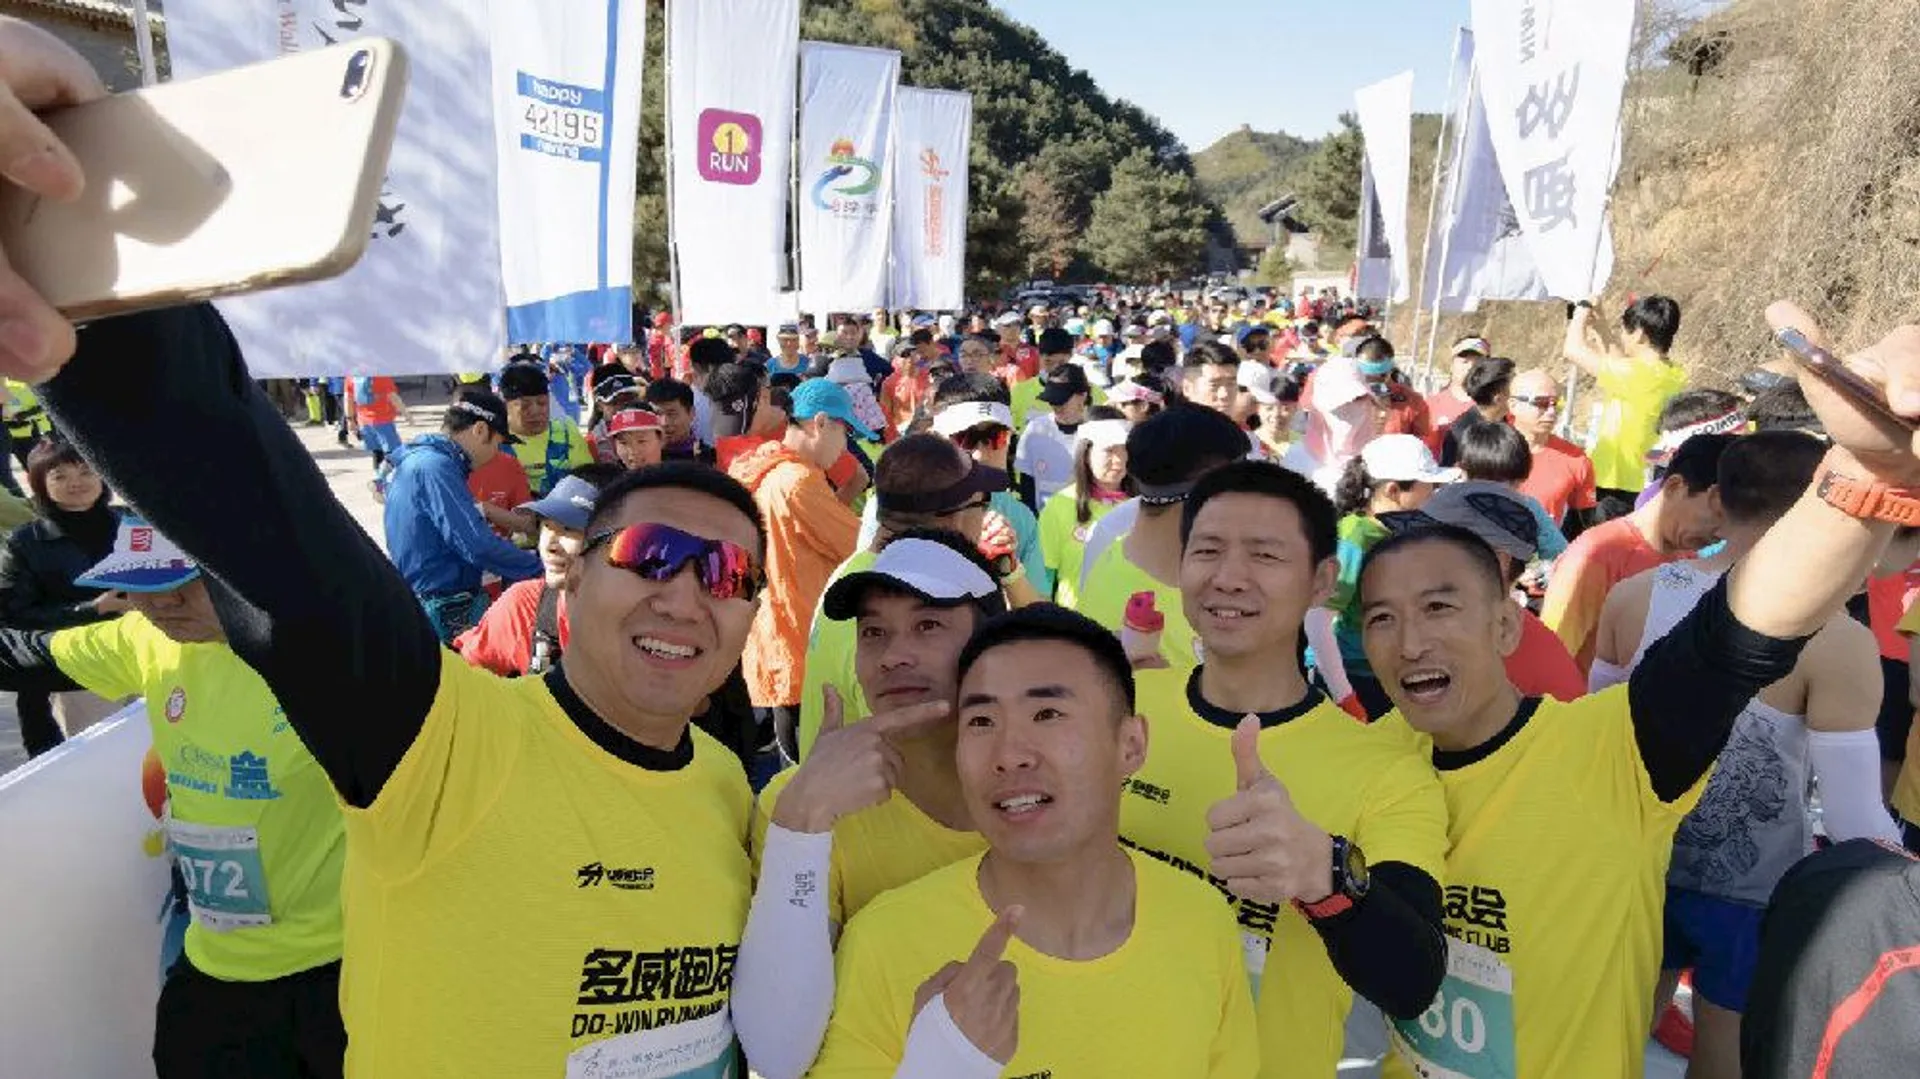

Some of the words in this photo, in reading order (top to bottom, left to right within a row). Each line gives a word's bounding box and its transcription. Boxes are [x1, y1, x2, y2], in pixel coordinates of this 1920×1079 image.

[532, 79, 582, 105] happy
[524, 103, 597, 144] 42195
[723, 129, 733, 153] 1
[709, 151, 749, 173] RUN
